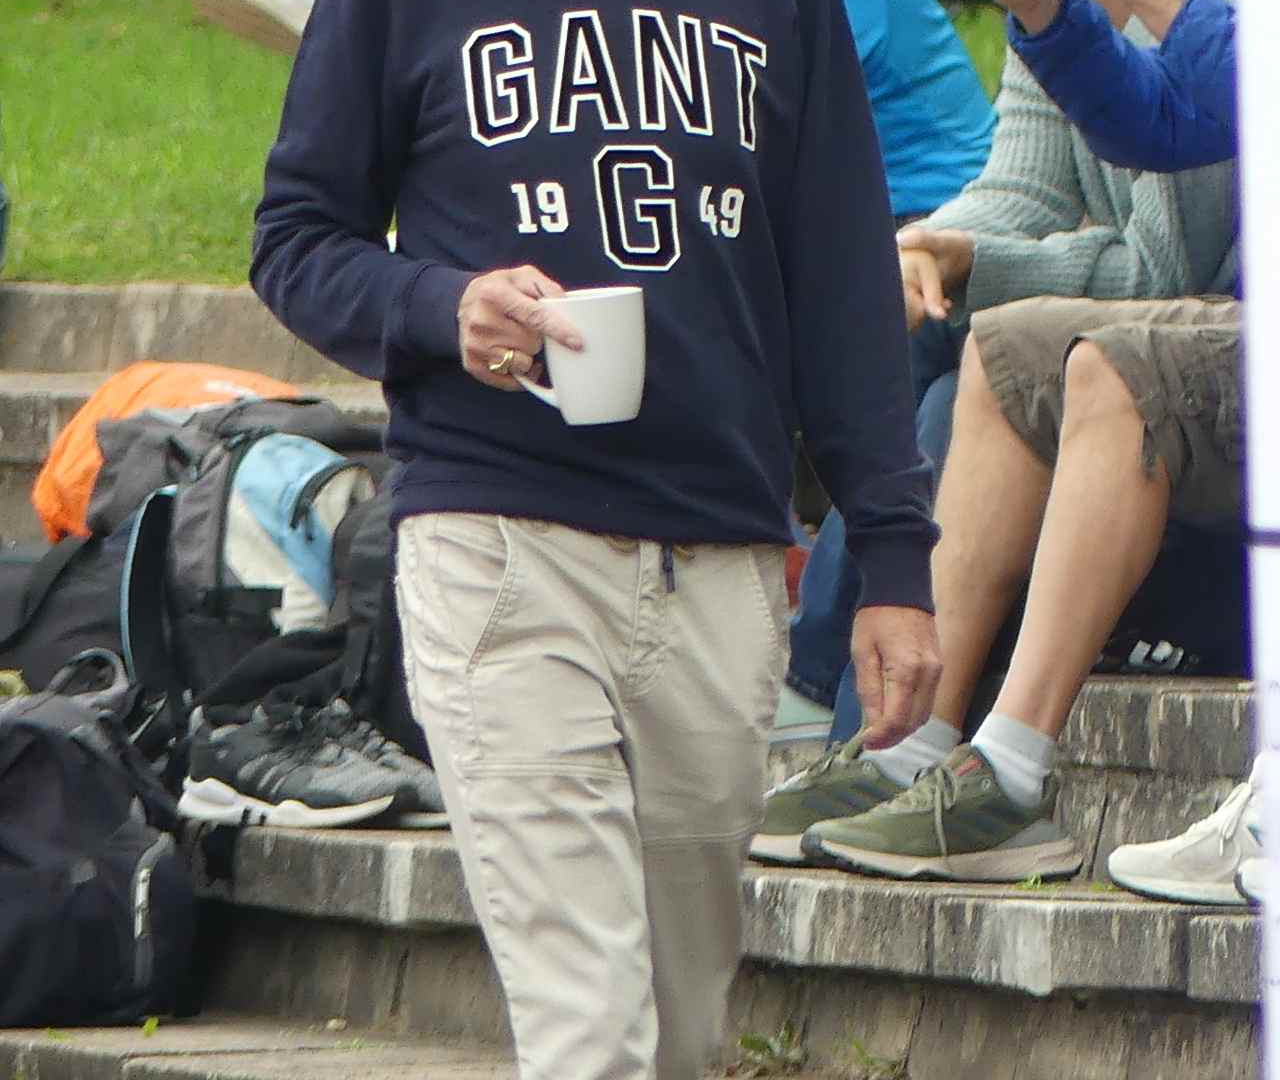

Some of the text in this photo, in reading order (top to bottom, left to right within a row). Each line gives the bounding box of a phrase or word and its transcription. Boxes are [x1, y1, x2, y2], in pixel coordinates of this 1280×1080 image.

[462, 9, 767, 151] GANT
[510, 144, 745, 271] 19 G 49
